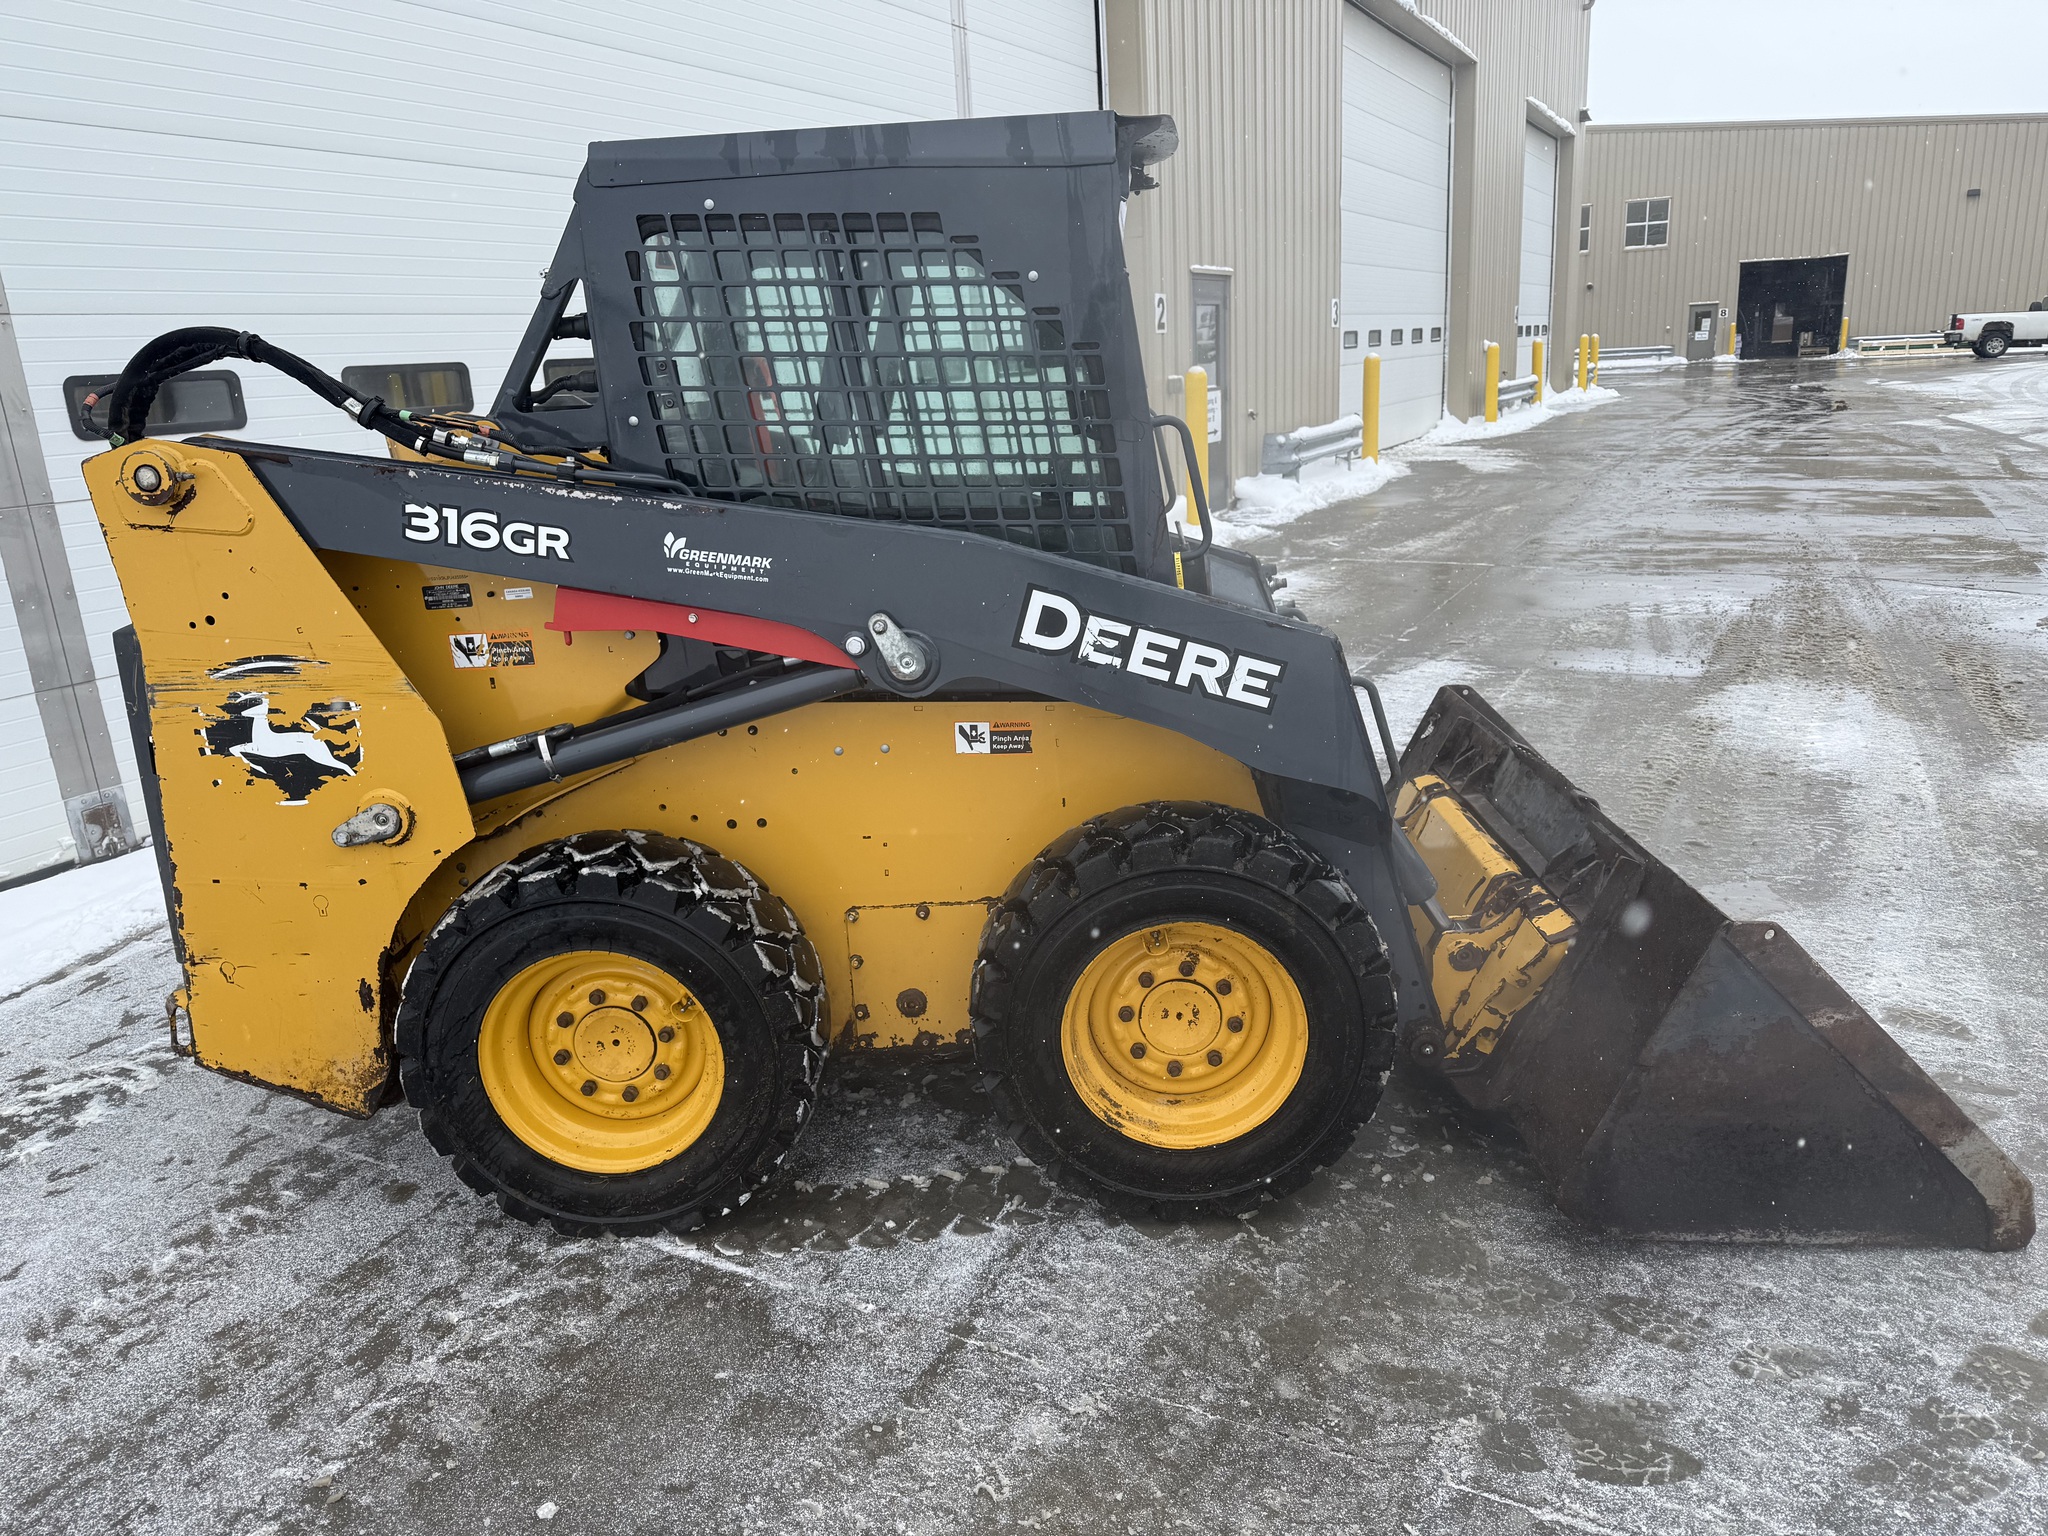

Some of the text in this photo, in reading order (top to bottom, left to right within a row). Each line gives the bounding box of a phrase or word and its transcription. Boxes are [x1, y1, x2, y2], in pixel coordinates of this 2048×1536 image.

[1157, 297, 1165, 330] 2
[1333, 301, 1339, 325] 3
[405, 503, 570, 560] 316GR
[679, 548, 773, 569] GREENMARK
[685, 561, 764, 574] EQUIPMENT
[667, 567, 769, 582] www.GreenMarkEquipment.com
[1019, 589, 1282, 709] DEERE
